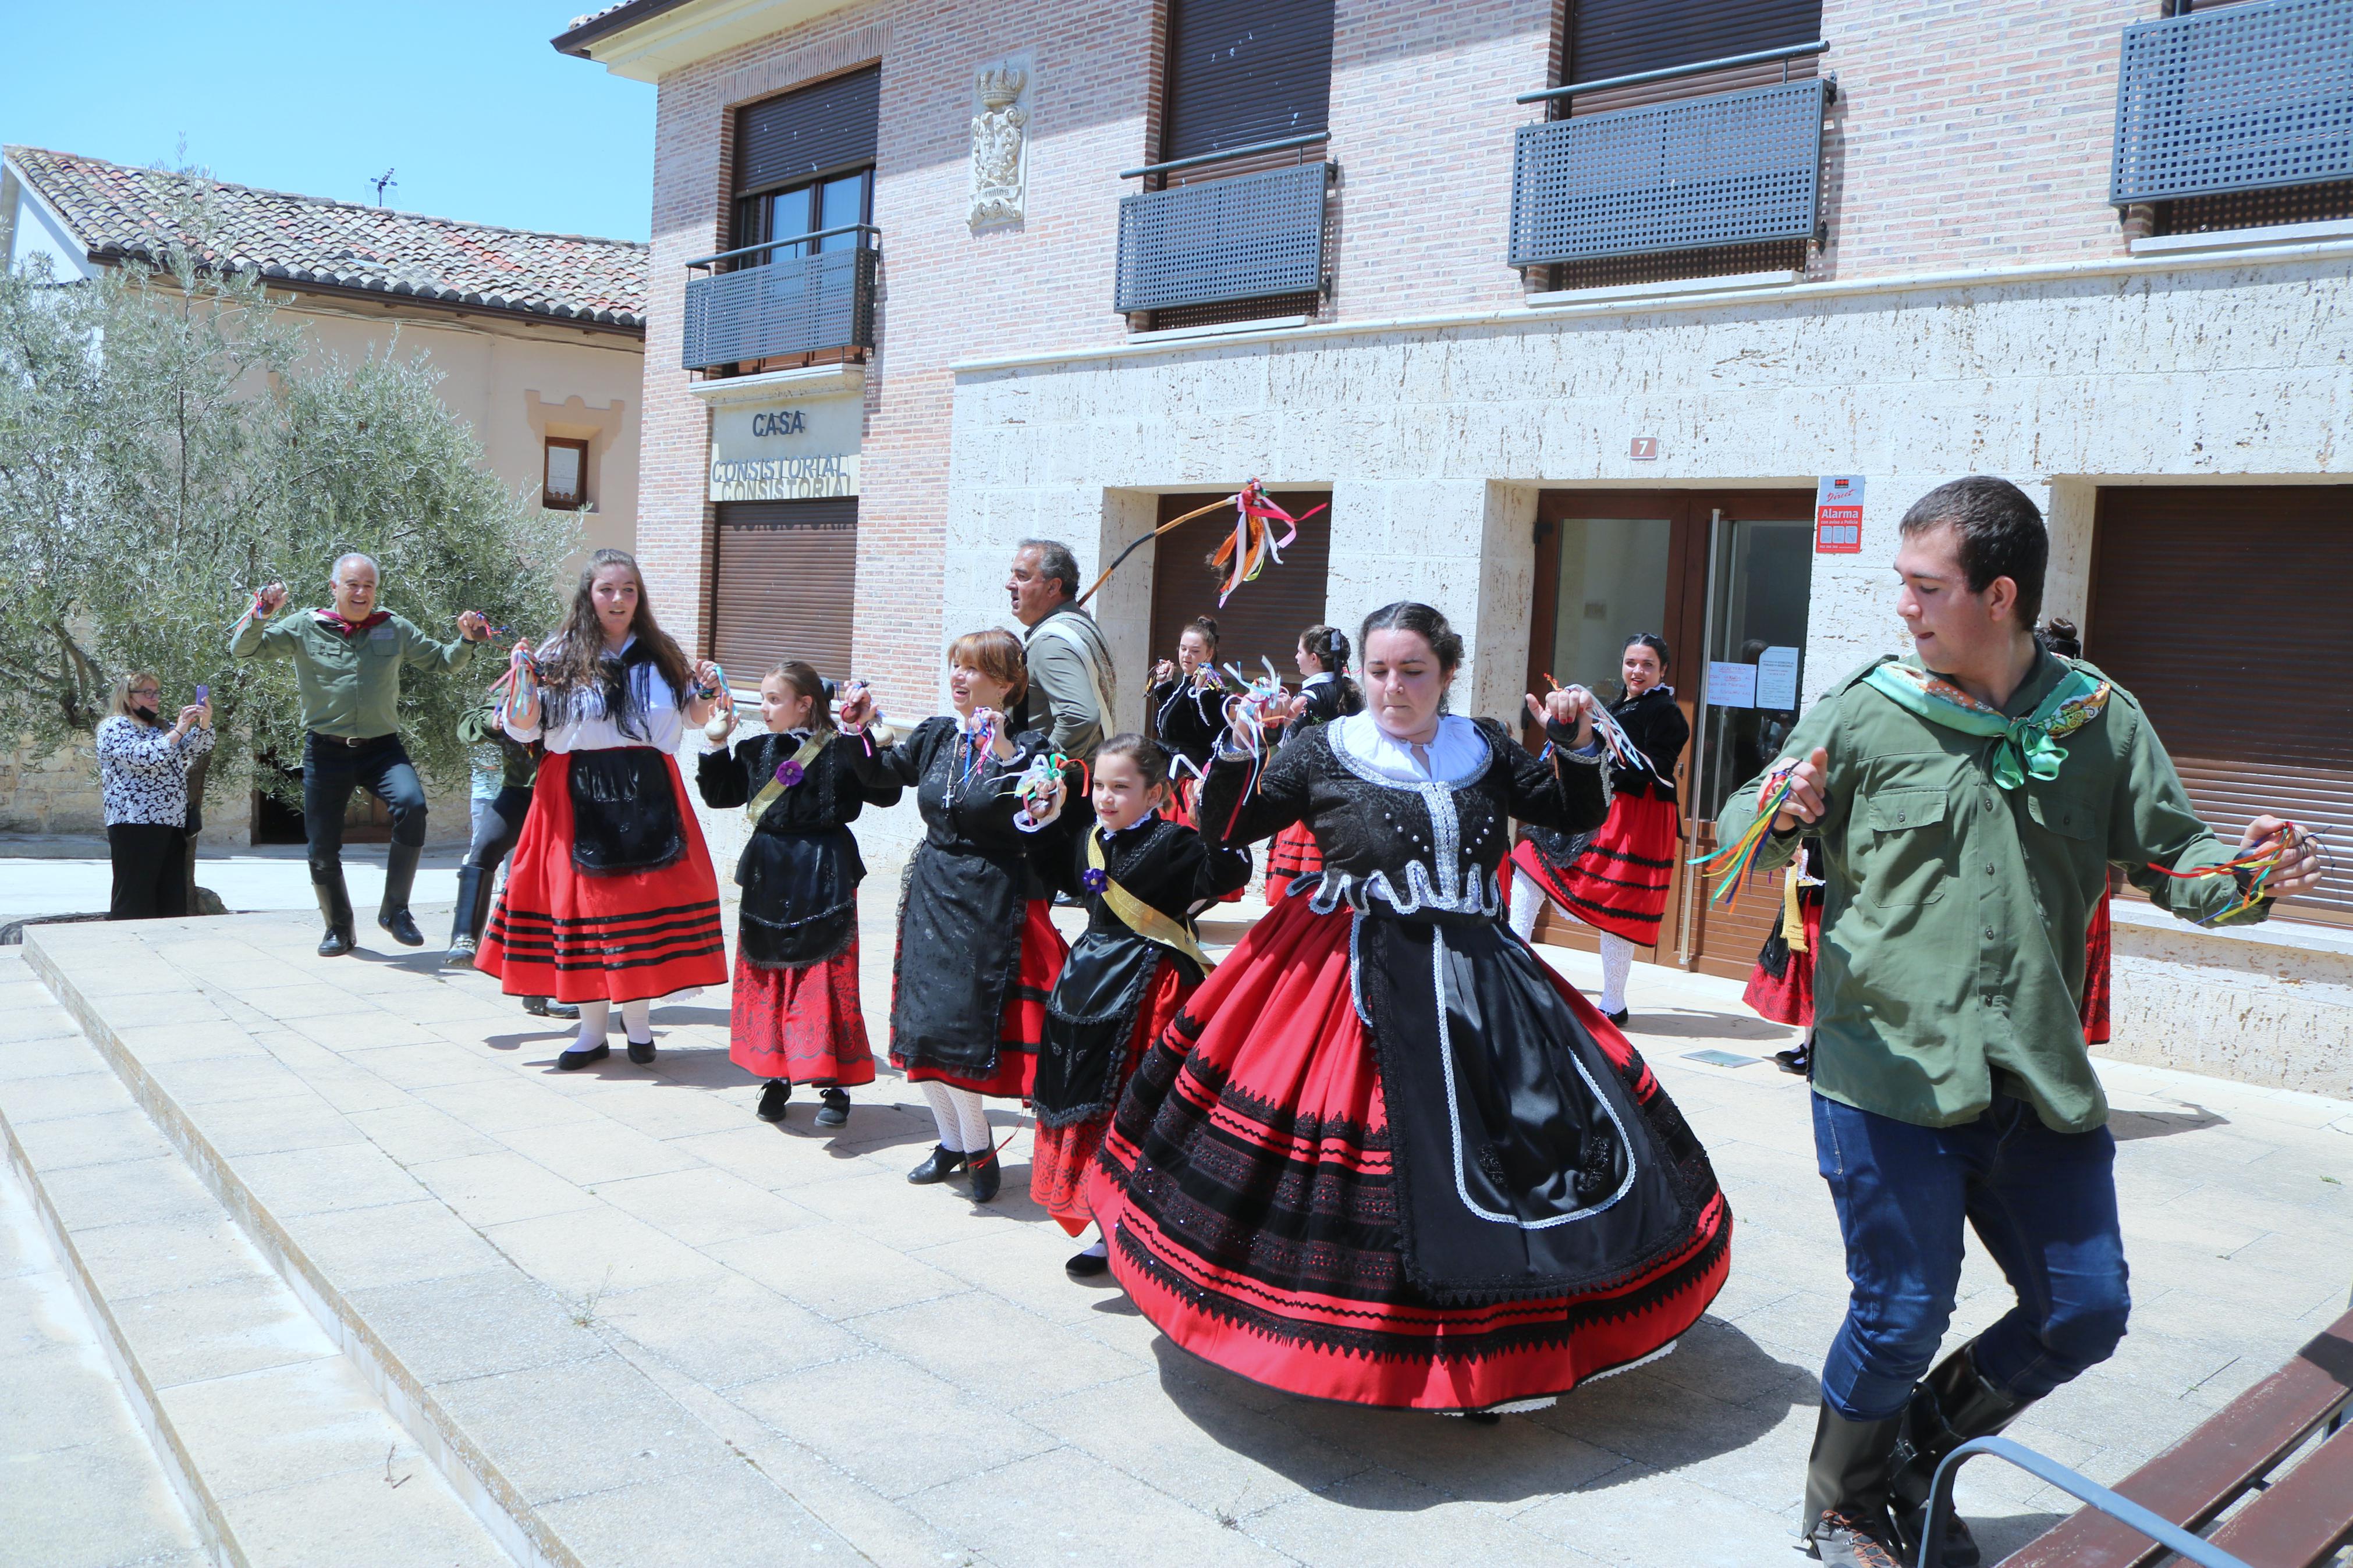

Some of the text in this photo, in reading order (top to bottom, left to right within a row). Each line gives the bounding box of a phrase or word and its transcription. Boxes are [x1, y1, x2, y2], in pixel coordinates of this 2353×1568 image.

[753, 410, 804, 437] CASA
[1638, 440, 1649, 455] 7
[712, 453, 848, 483] CONSISTORIAL
[1826, 489, 1857, 502] Direct
[1821, 508, 1858, 518] Alarma
